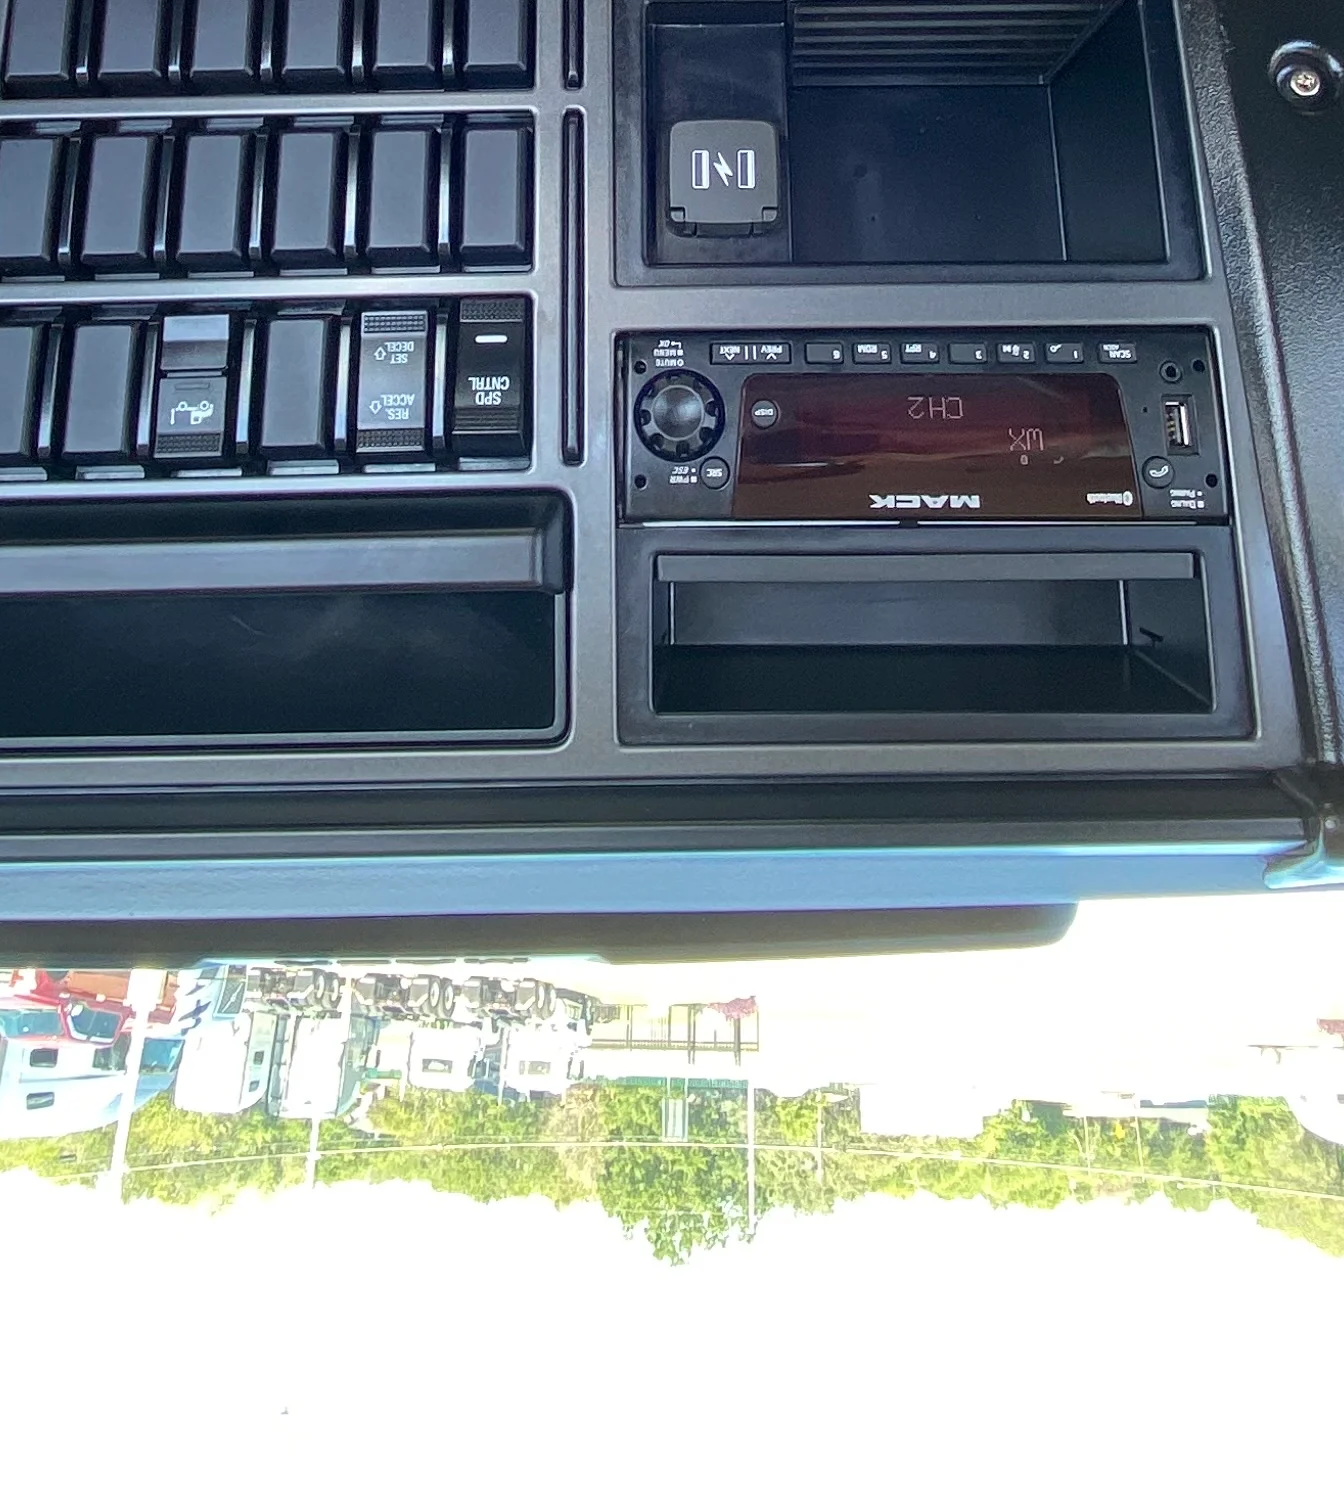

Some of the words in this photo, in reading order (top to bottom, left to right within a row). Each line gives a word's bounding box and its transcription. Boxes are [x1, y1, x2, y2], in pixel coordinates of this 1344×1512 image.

[384, 341, 415, 353] DECEL
[719, 345, 740, 354] NEXT
[760, 344, 783, 354] PREV
[905, 344, 922, 353] RPT
[653, 348, 677, 357] MENU
[881, 351, 888, 360] 5
[929, 351, 936, 359] 4
[975, 351, 983, 360] 3
[1023, 350, 1030, 360] 2
[1109, 349, 1132, 359] SCAN
[390, 353, 408, 364] SET
[468, 376, 510, 390] CNTRL
[380, 393, 415, 406] ACCEL
[475, 391, 502, 405] SPD
[754, 408, 774, 416] DISP
[907, 396, 964, 419] CH2
[1008, 428, 1044, 451] WX
[671, 466, 689, 475] ESC
[706, 468, 723, 477] SRC
[669, 475, 690, 484] PWR
[868, 494, 981, 509] MACK
